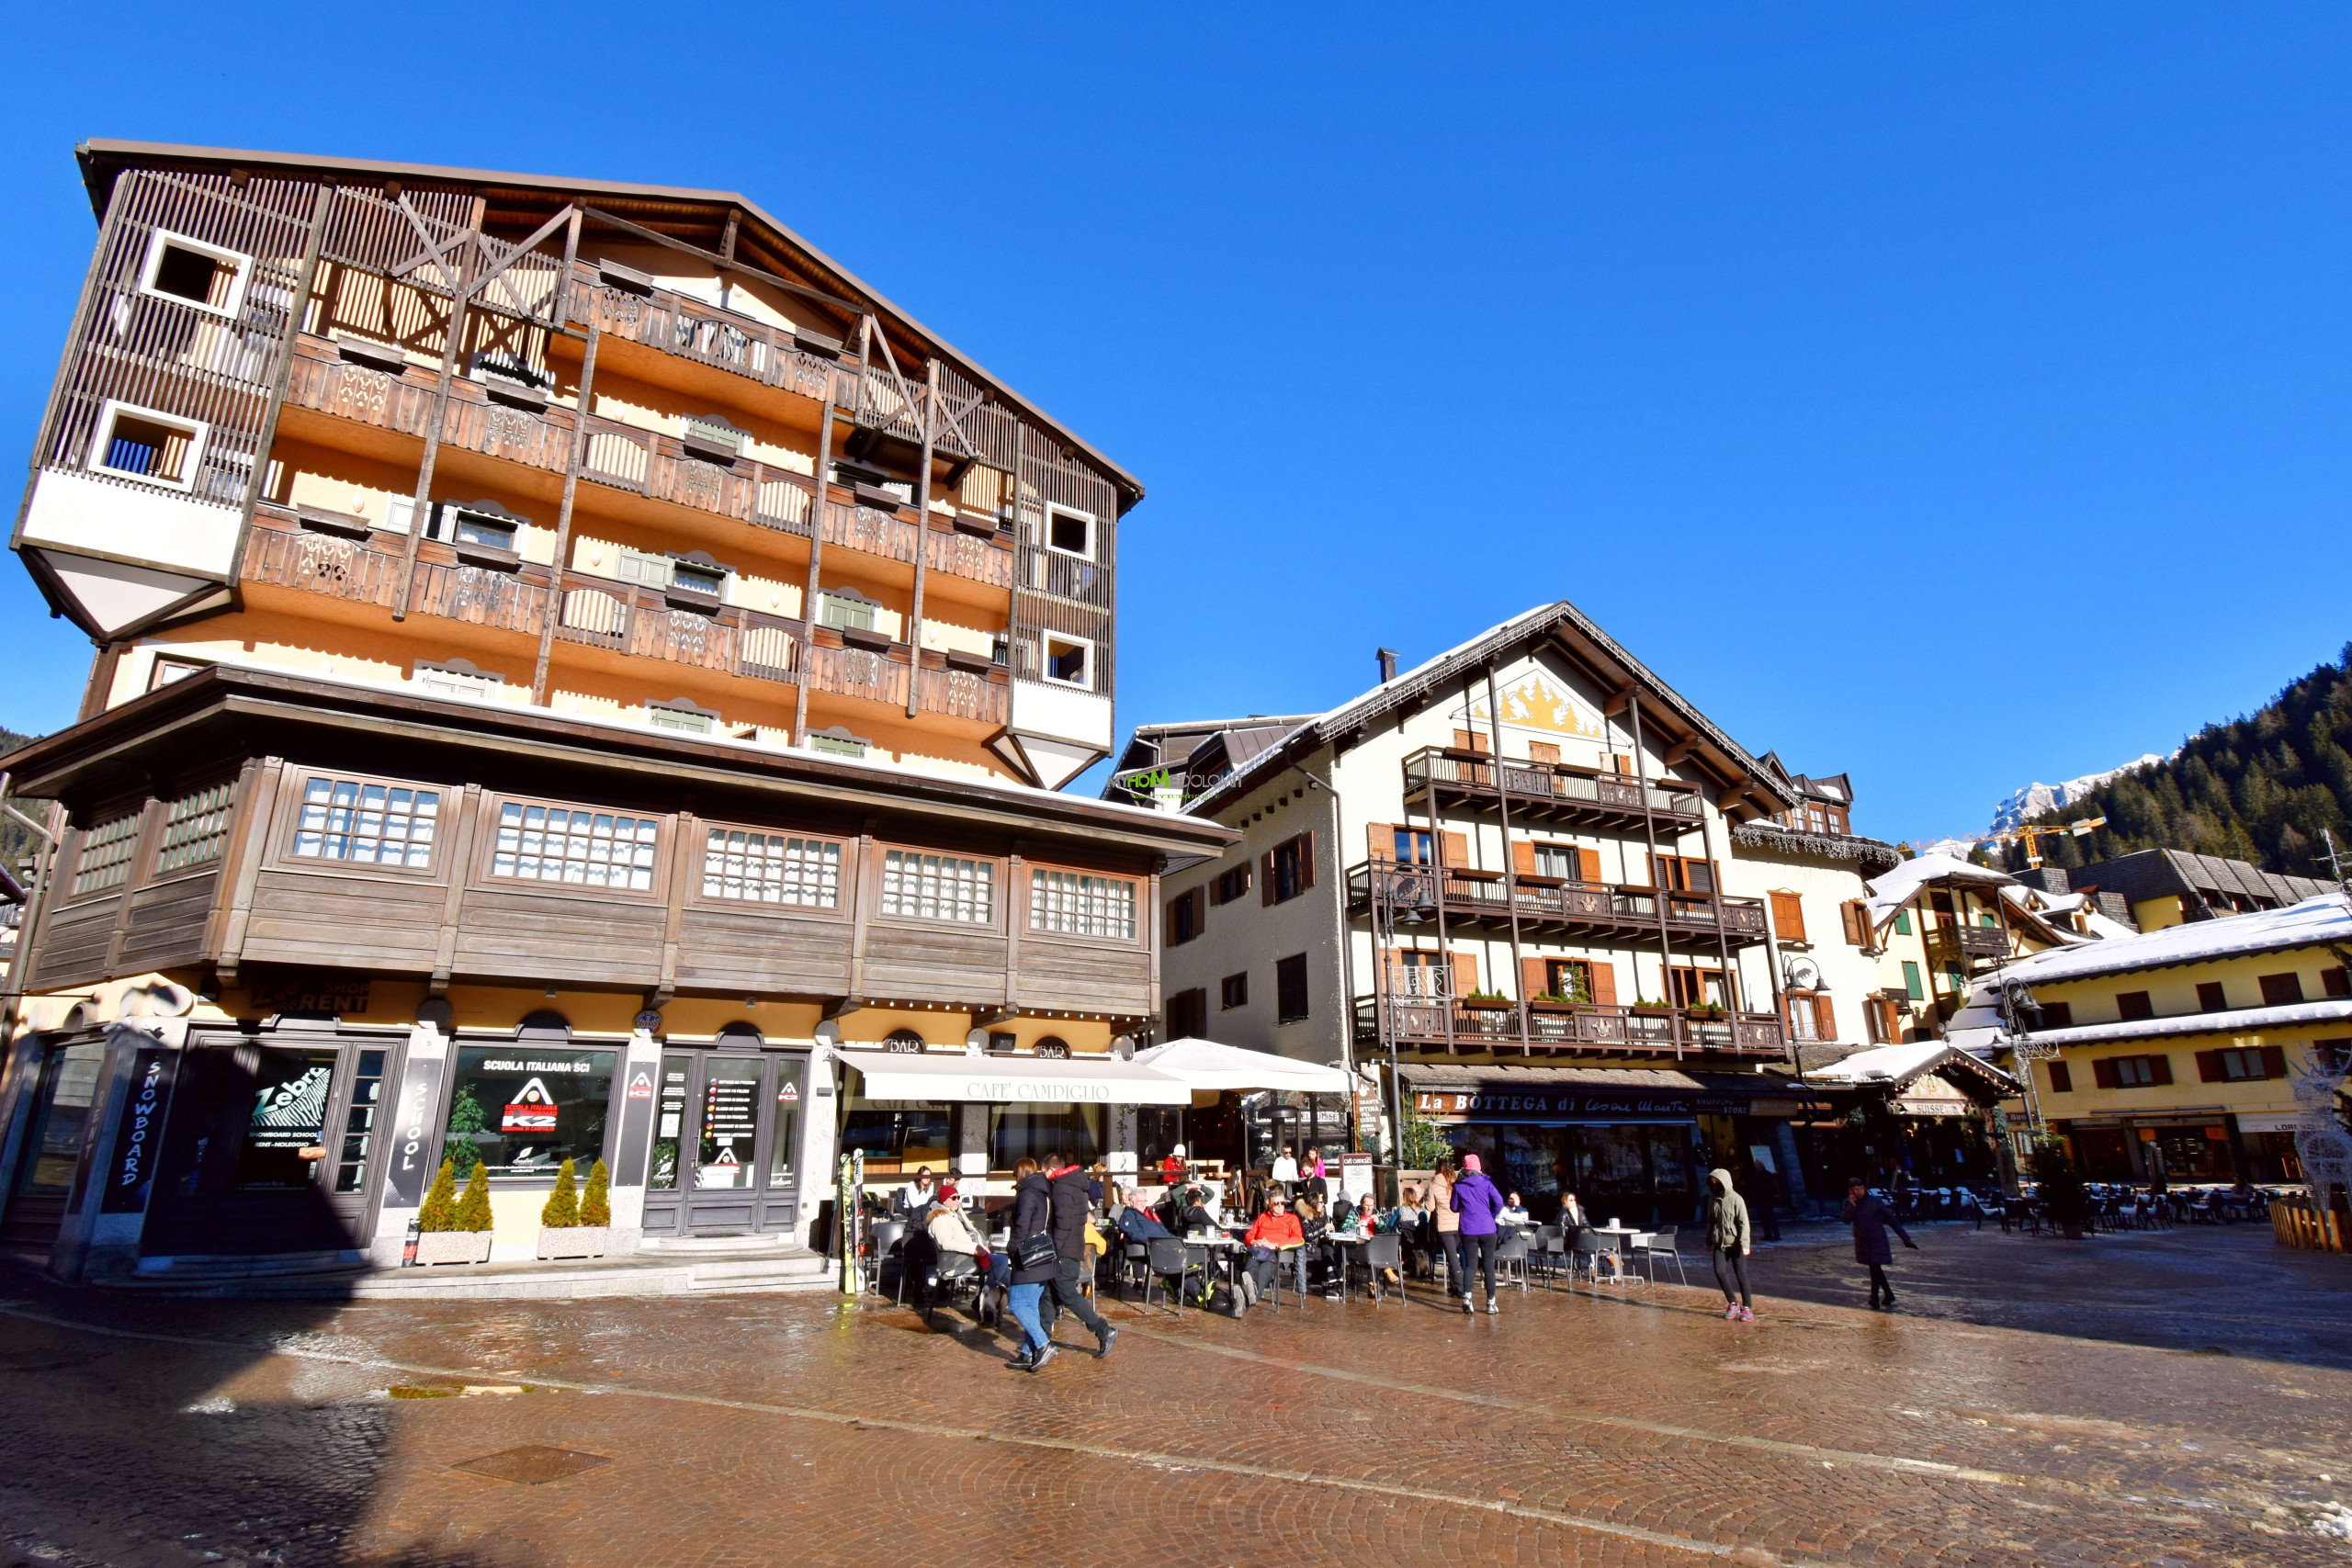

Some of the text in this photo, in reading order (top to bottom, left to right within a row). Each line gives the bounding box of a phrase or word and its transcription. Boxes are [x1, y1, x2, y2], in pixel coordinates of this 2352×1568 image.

[299, 993, 368, 1011] RENT
[890, 1040, 918, 1053] BAR
[1040, 1045, 1064, 1059] BAR
[483, 1060, 591, 1073] SCUOLA ITALIANA SCI
[252, 1067, 328, 1116] Zebra
[1017, 1084, 1109, 1100] CAMPIGLIO
[1420, 1094, 1442, 1110] La
[1455, 1094, 1548, 1111] BOTTEGA
[1557, 1098, 1576, 1111] di
[1724, 1106, 1748, 1114] STORE
[1917, 1104, 1944, 1115] SUISSE
[122, 1061, 161, 1186] SNOWBOARD
[402, 1082, 428, 1171] SCHOOL
[502, 1115, 557, 1127] K2
